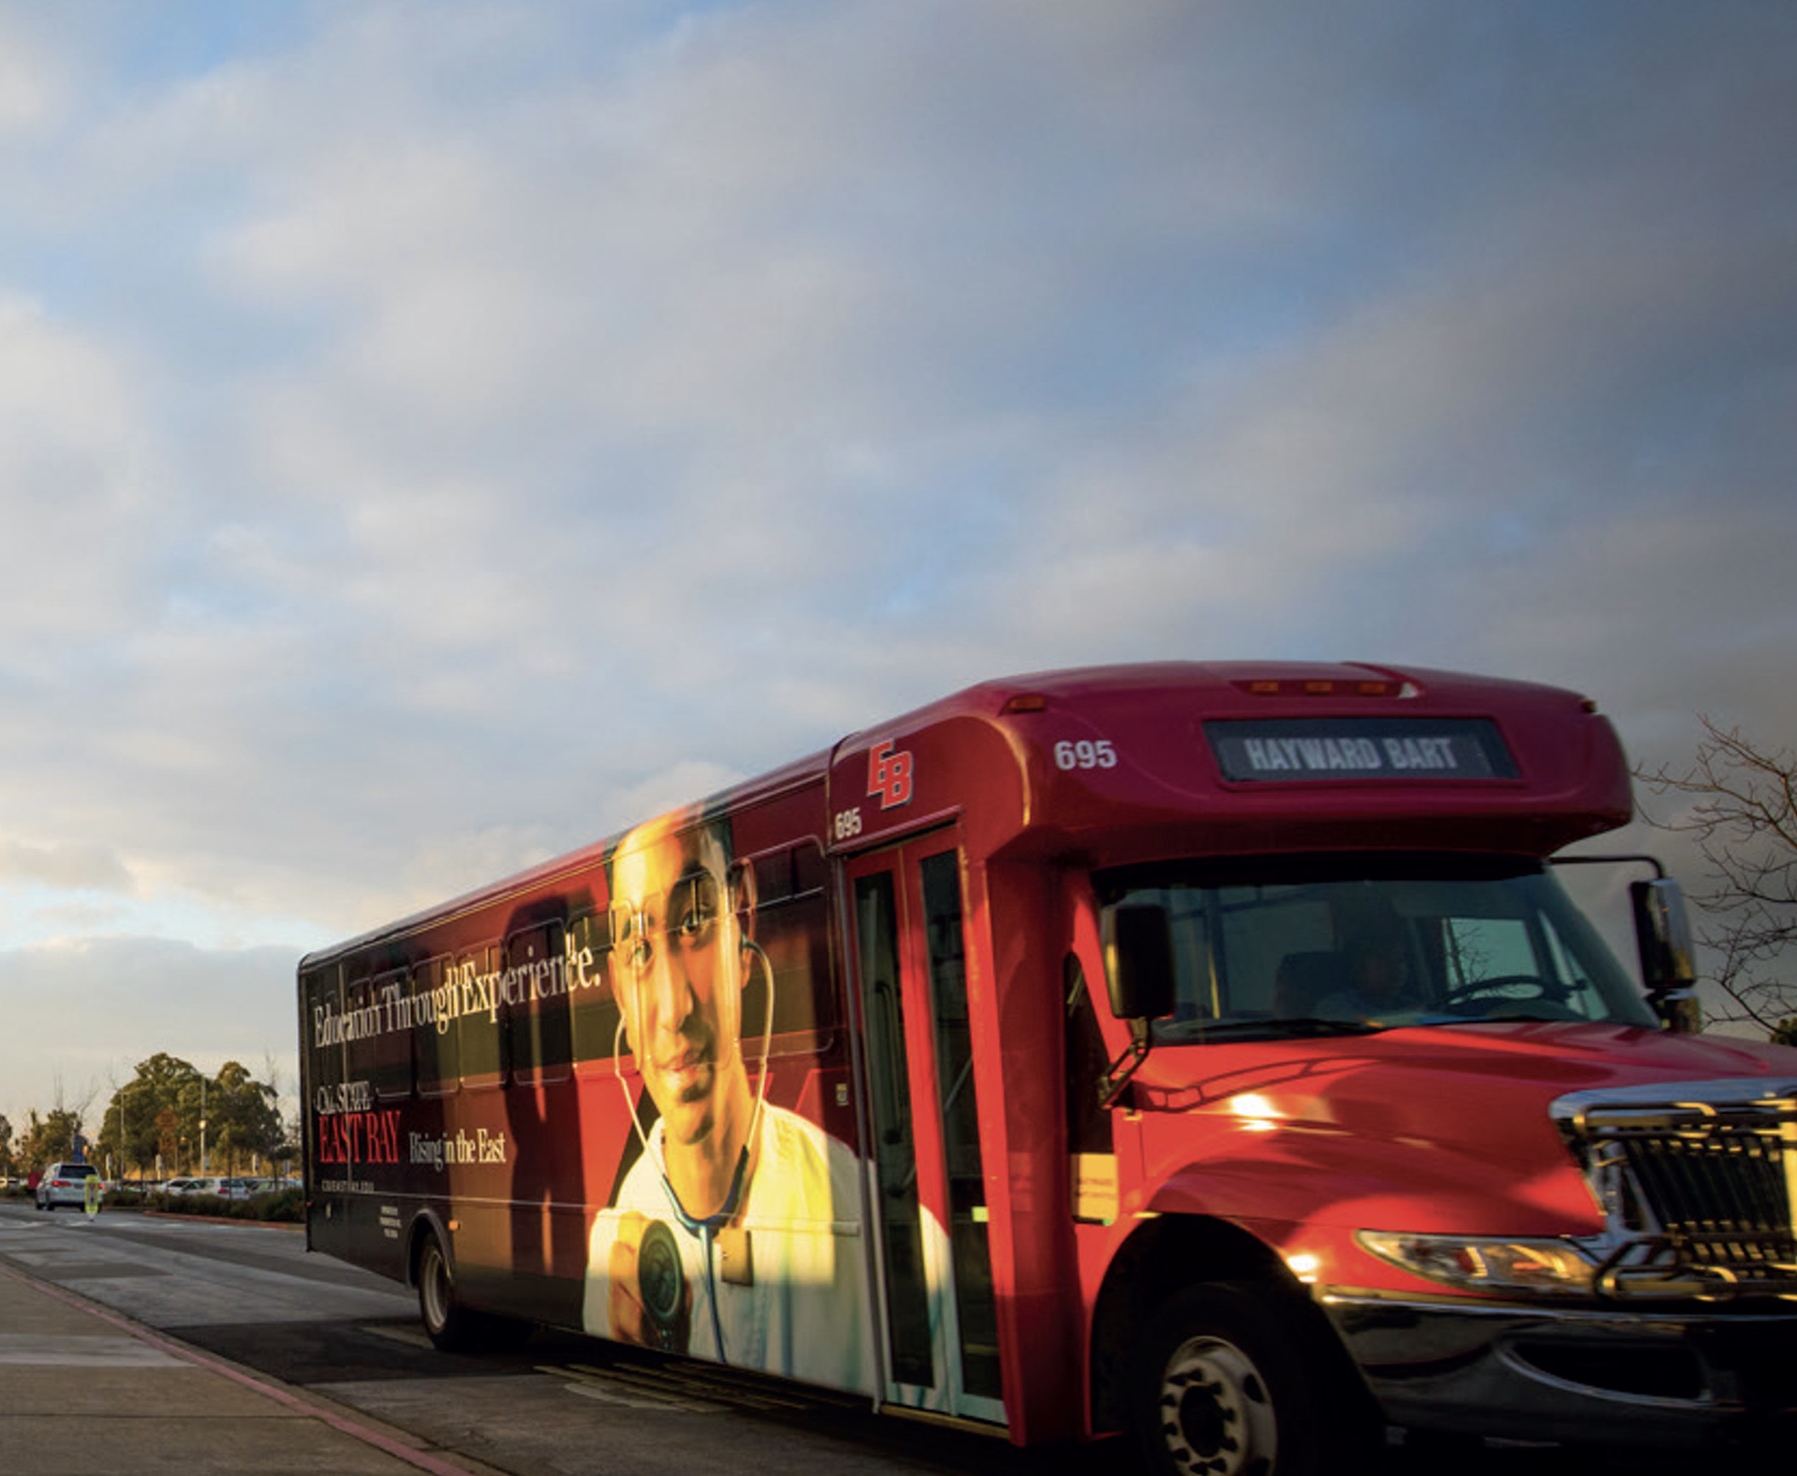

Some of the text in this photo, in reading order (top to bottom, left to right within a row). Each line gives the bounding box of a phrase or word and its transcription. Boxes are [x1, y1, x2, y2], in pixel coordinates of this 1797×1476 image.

[867, 737, 914, 810] EB
[1054, 740, 1117, 770] 695
[1244, 737, 1457, 770] HAYWARD BART
[835, 807, 862, 839] 695
[314, 945, 601, 1048] Education Through Experience.
[319, 1110, 401, 1163] EAST BAY
[408, 1128, 506, 1172] Rising in the East
